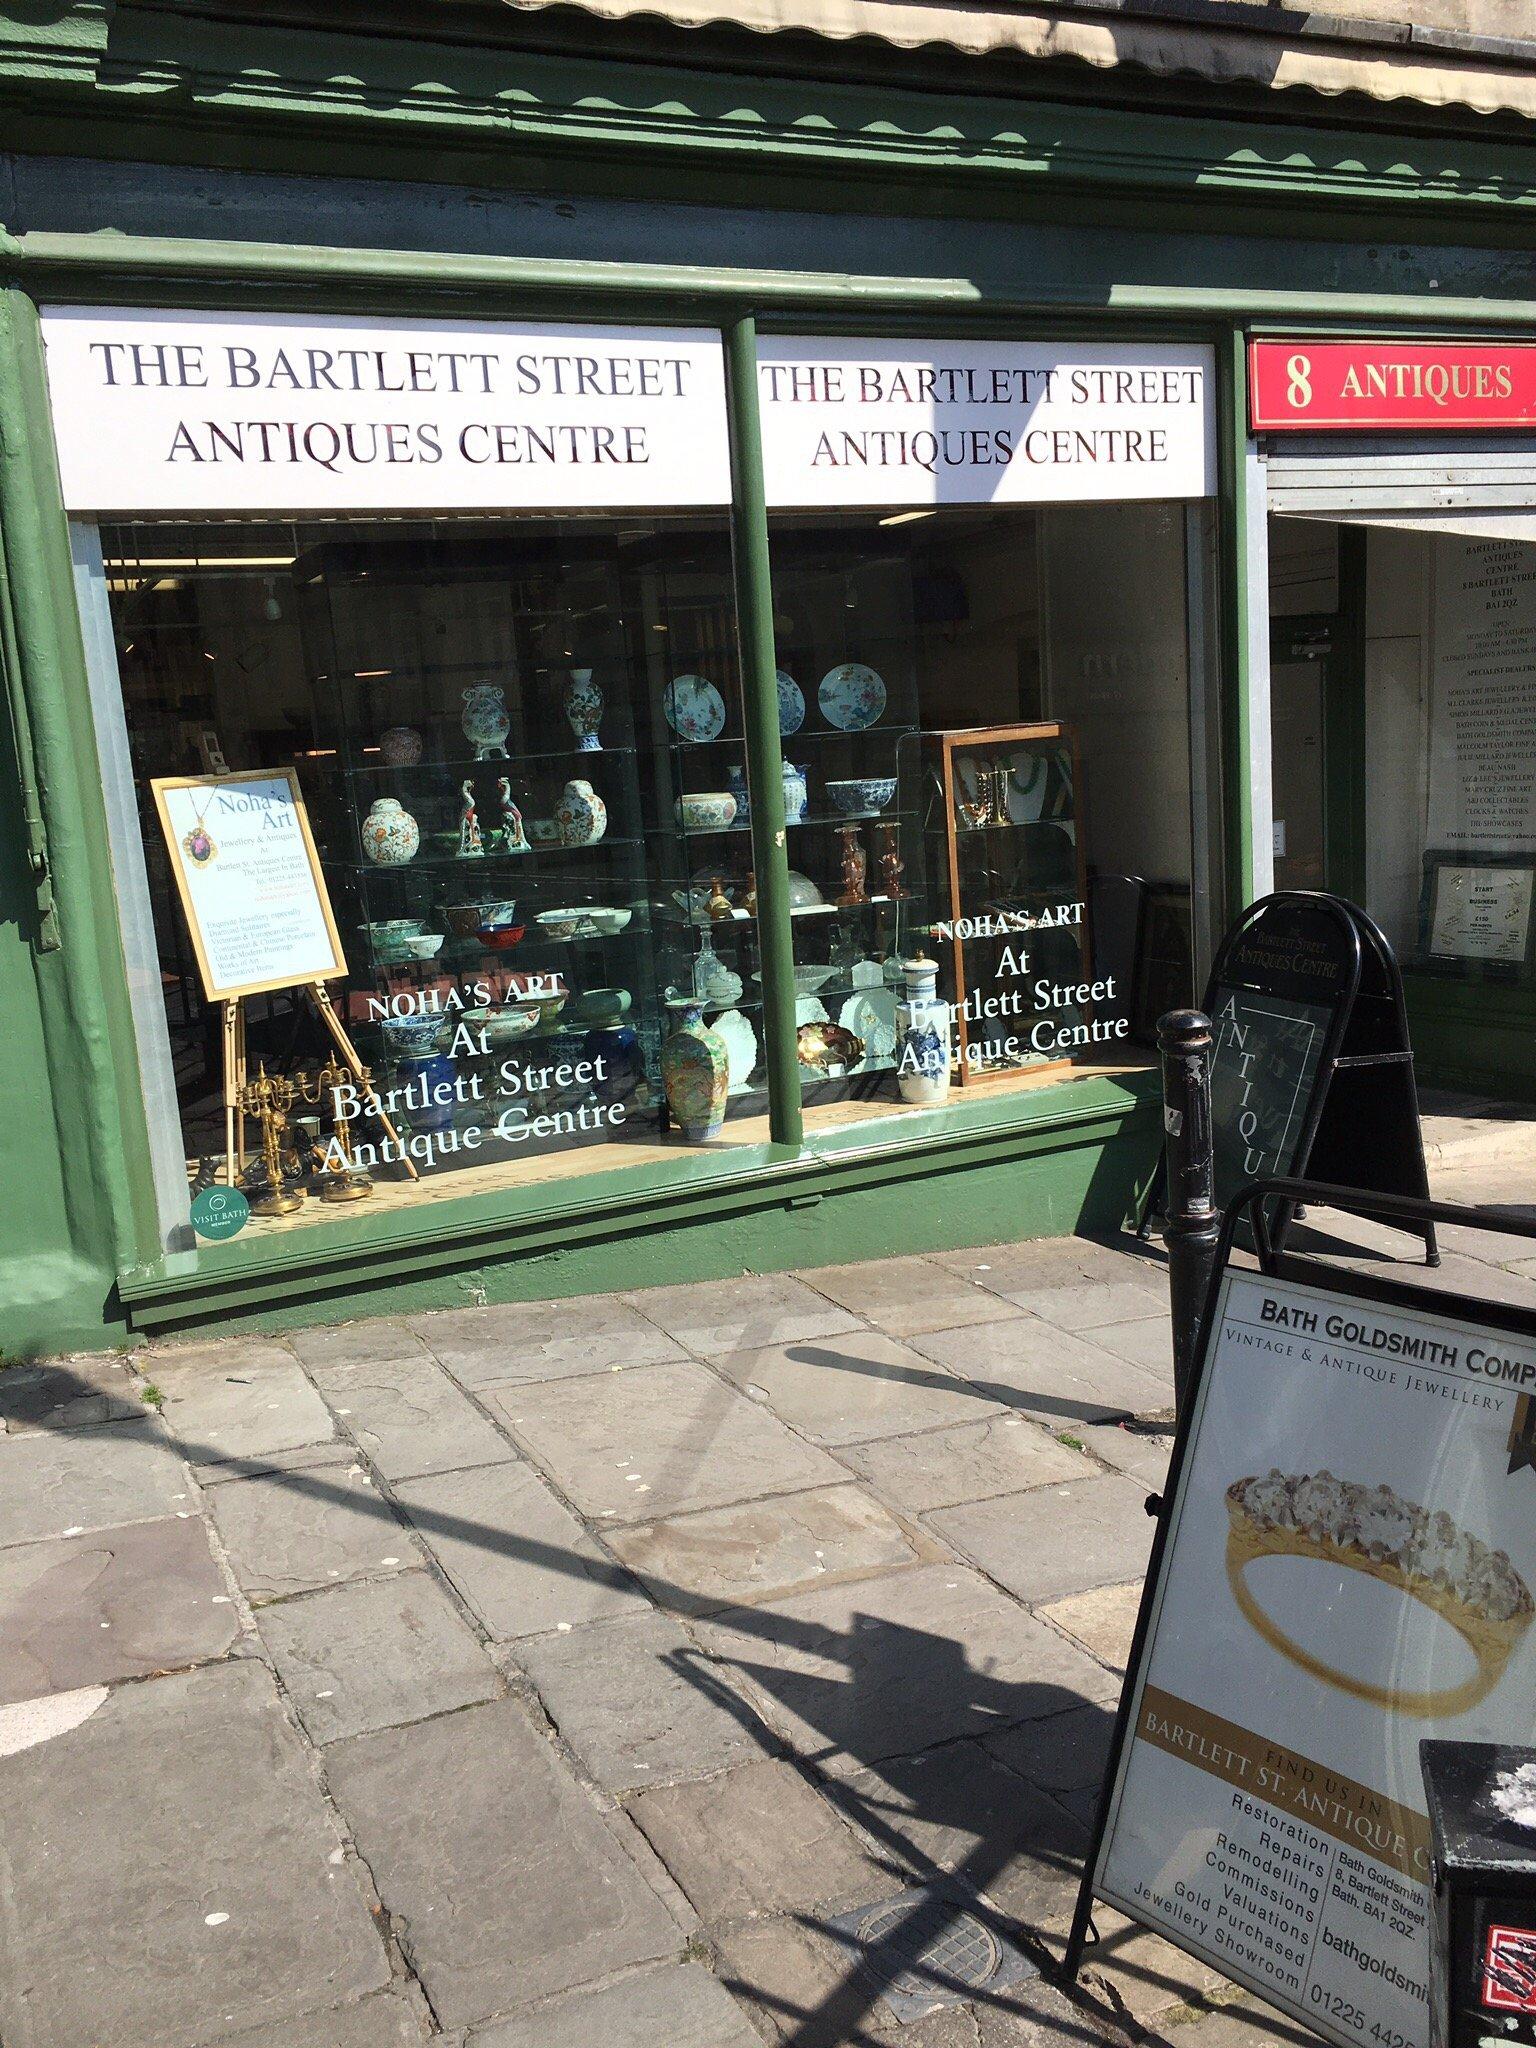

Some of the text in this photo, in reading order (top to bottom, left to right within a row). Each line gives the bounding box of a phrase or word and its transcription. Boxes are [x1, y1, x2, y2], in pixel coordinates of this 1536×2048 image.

[89, 342, 692, 400] THE BARTLETT STREET
[760, 365, 1205, 404] THE BARTLETT STREET
[1286, 355, 1513, 408] 8 ANTIQUES
[164, 421, 650, 474] ANTIQUES CENTRE
[810, 430, 1168, 475] ANTIQUES CENTRE
[1483, 551, 1523, 564] ANTIQUES
[1486, 564, 1519, 575] CENTRE
[1491, 588, 1513, 598] BATH
[217, 791, 288, 815] Noha's
[262, 810, 293, 830] Art
[937, 902, 1085, 944] NOHA'S ART
[995, 945, 1030, 977] At
[1234, 945, 1338, 979] ANTIQUES CENTRE
[365, 972, 564, 1023] NOHA'S ART
[1034, 975, 1116, 1011] Street
[447, 1022, 493, 1059] At
[1031, 1018, 1128, 1051] Centre
[329, 1054, 607, 1121] Bartlett Street
[1220, 994, 1266, 1176] ANTIQU
[318, 1103, 626, 1174] Antique Centre
[194, 1209, 246, 1224] VISIT BATH
[1225, 1328, 1505, 1413] VINTAGE & ANTIQUE JEWELLERY
[1260, 1299, 1536, 1388] BATH GOLDSMITH COMP
[1146, 1711, 1406, 1858] BARTLETT ST. ANTIQUE
[1266, 1749, 1382, 1817] FIND US IN
[1232, 1793, 1329, 1856] Restoration
[1217, 1833, 1319, 1903] Remodelling
[1259, 1832, 1324, 1878] Repairs
[1339, 1851, 1425, 1907] Bath Goldsmith
[1205, 1851, 1314, 1923] Commissions
[1332, 1884, 1416, 1941] Bath. BA1 2QZ.
[1335, 1868, 1426, 1927] 8, Bartlett Street
[1133, 1881, 1299, 1989] Jewellery Showroom
[1174, 1881, 1306, 1968] Gold Purchased
[1223, 1884, 1309, 1945] Valuations
[1310, 1984, 1416, 2048] 01225 442
